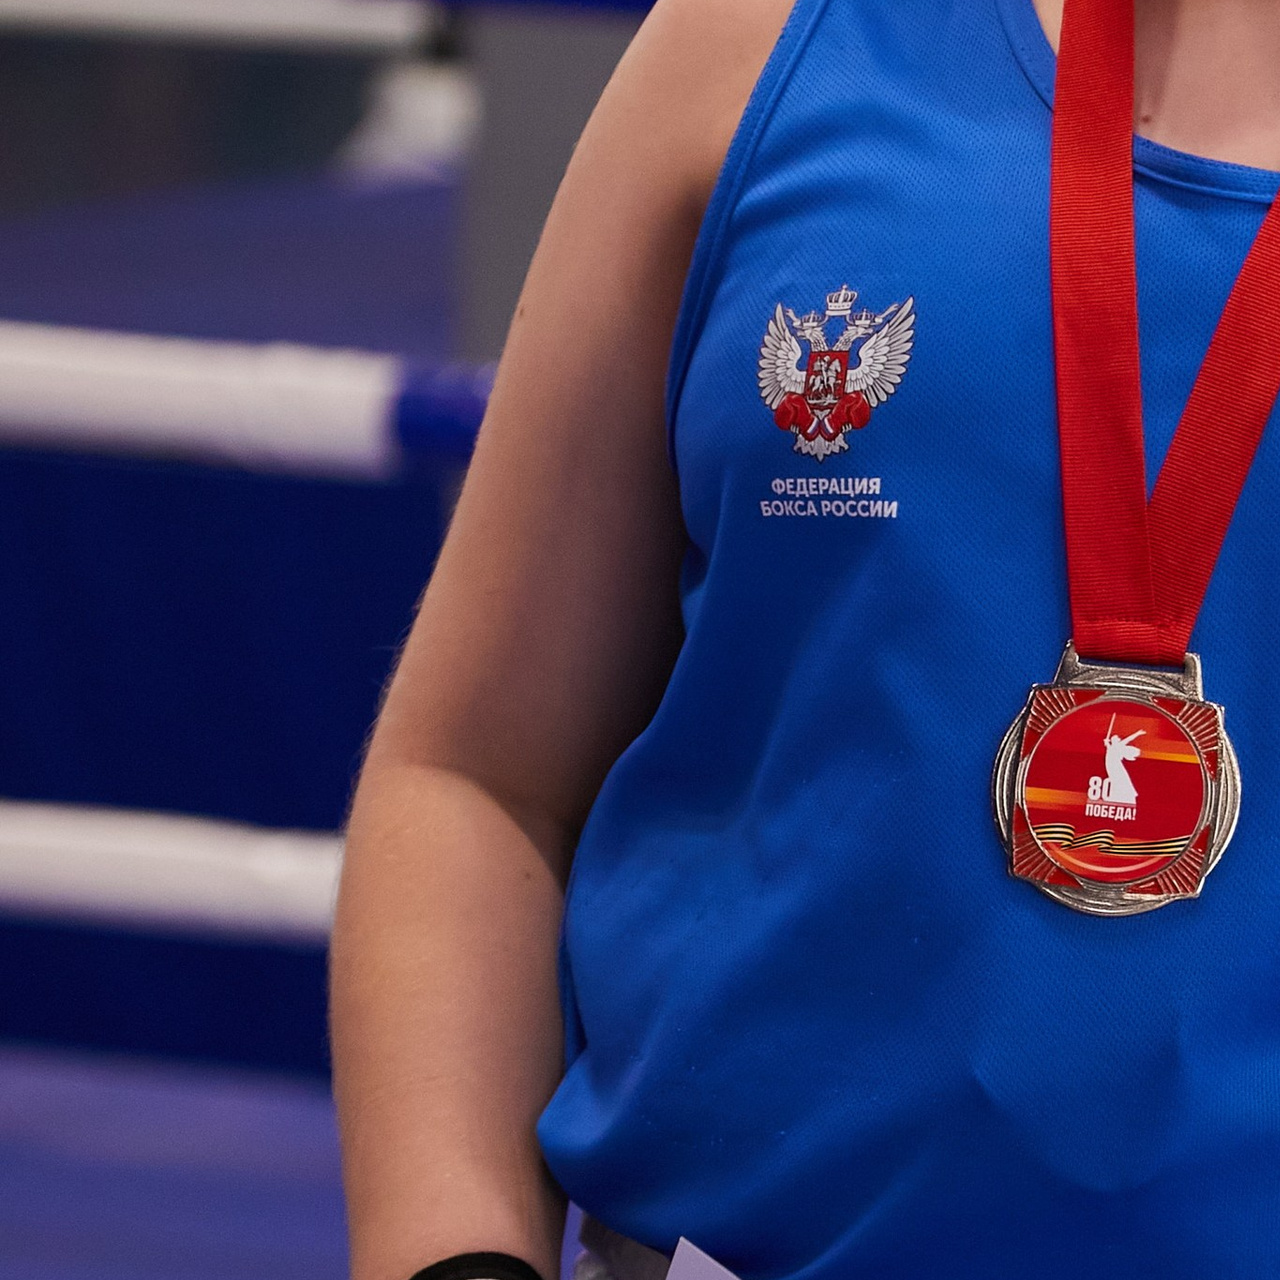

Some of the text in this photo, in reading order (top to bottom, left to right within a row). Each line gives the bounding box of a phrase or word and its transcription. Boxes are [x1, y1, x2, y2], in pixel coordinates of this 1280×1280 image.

[771, 477, 882, 498] ФЕДЕРАЦИЯ
[760, 500, 898, 519] БОКСА РОССИИ
[1085, 803, 1137, 822] ПОБЕДА!
